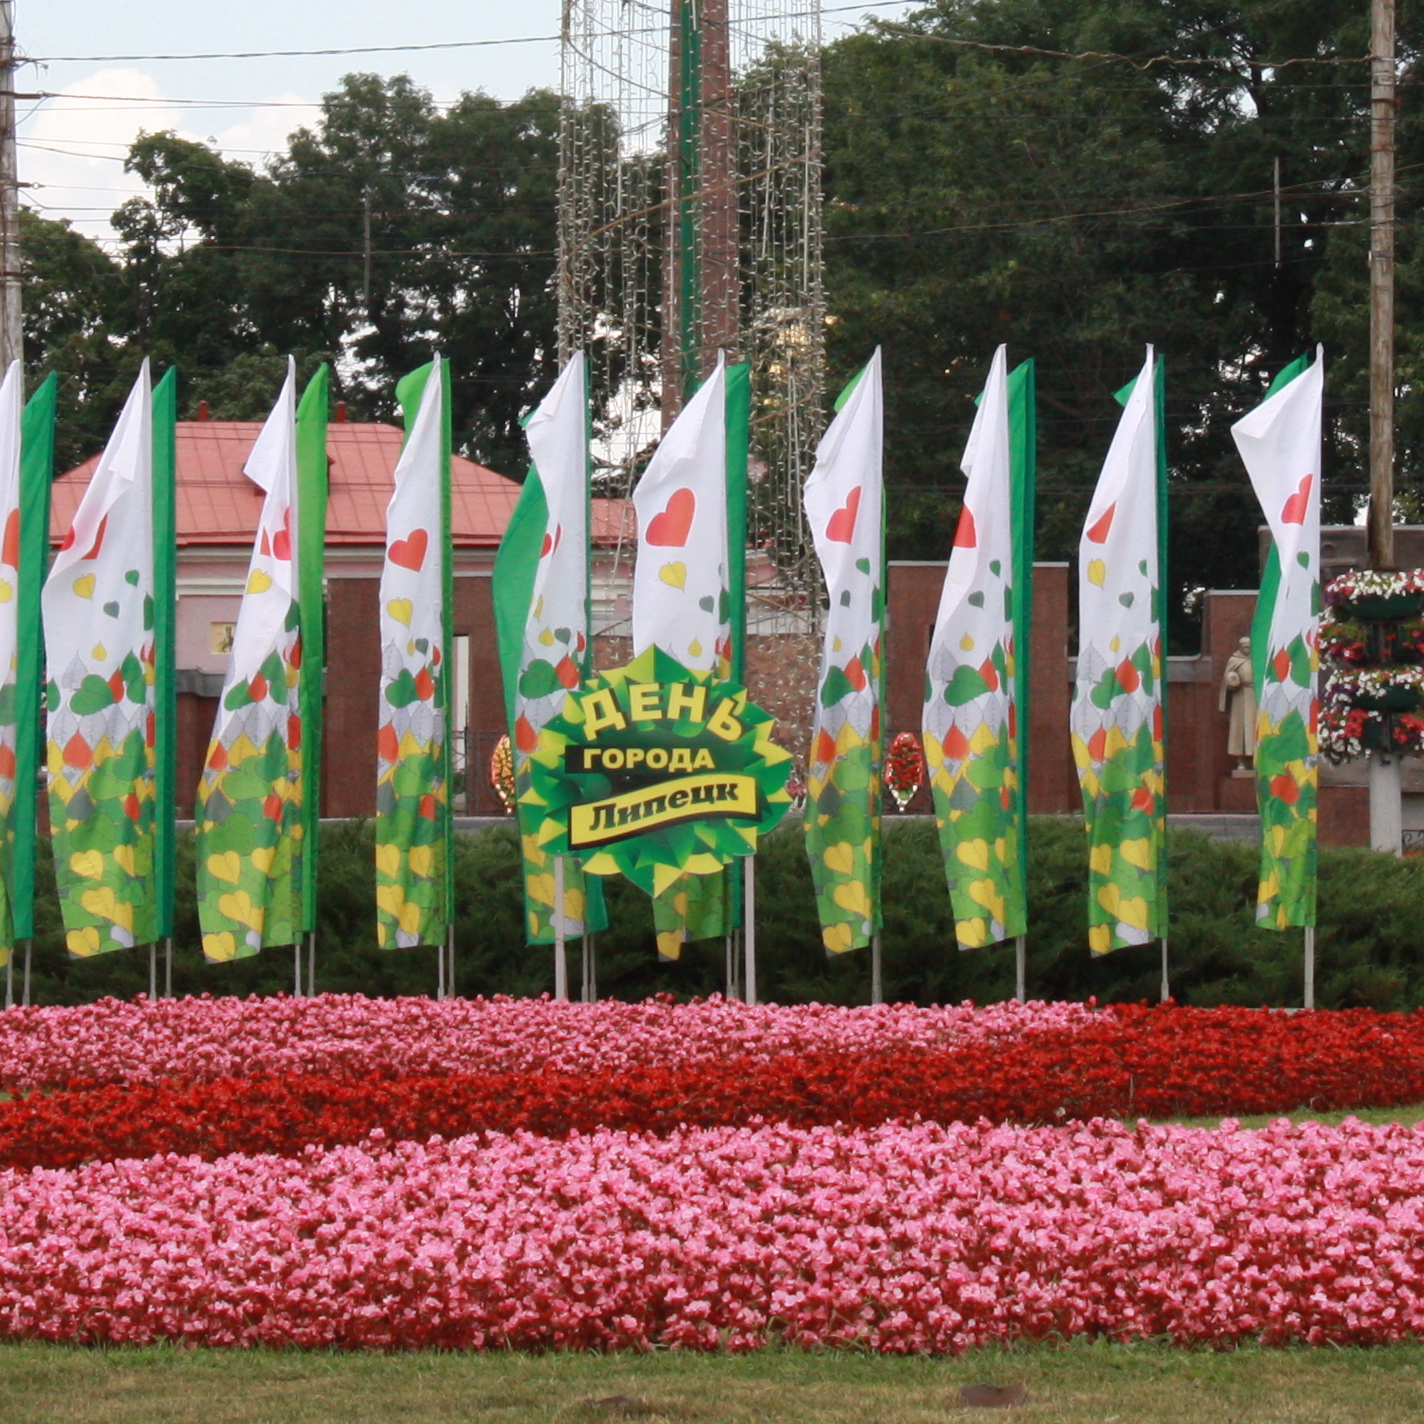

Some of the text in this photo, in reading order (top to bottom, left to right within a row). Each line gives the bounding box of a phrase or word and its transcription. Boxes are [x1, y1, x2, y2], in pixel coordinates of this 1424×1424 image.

[580, 682, 743, 742] ДЕНЬ
[583, 748, 716, 773] ГОРОДА
[589, 783, 739, 831] Липецк
